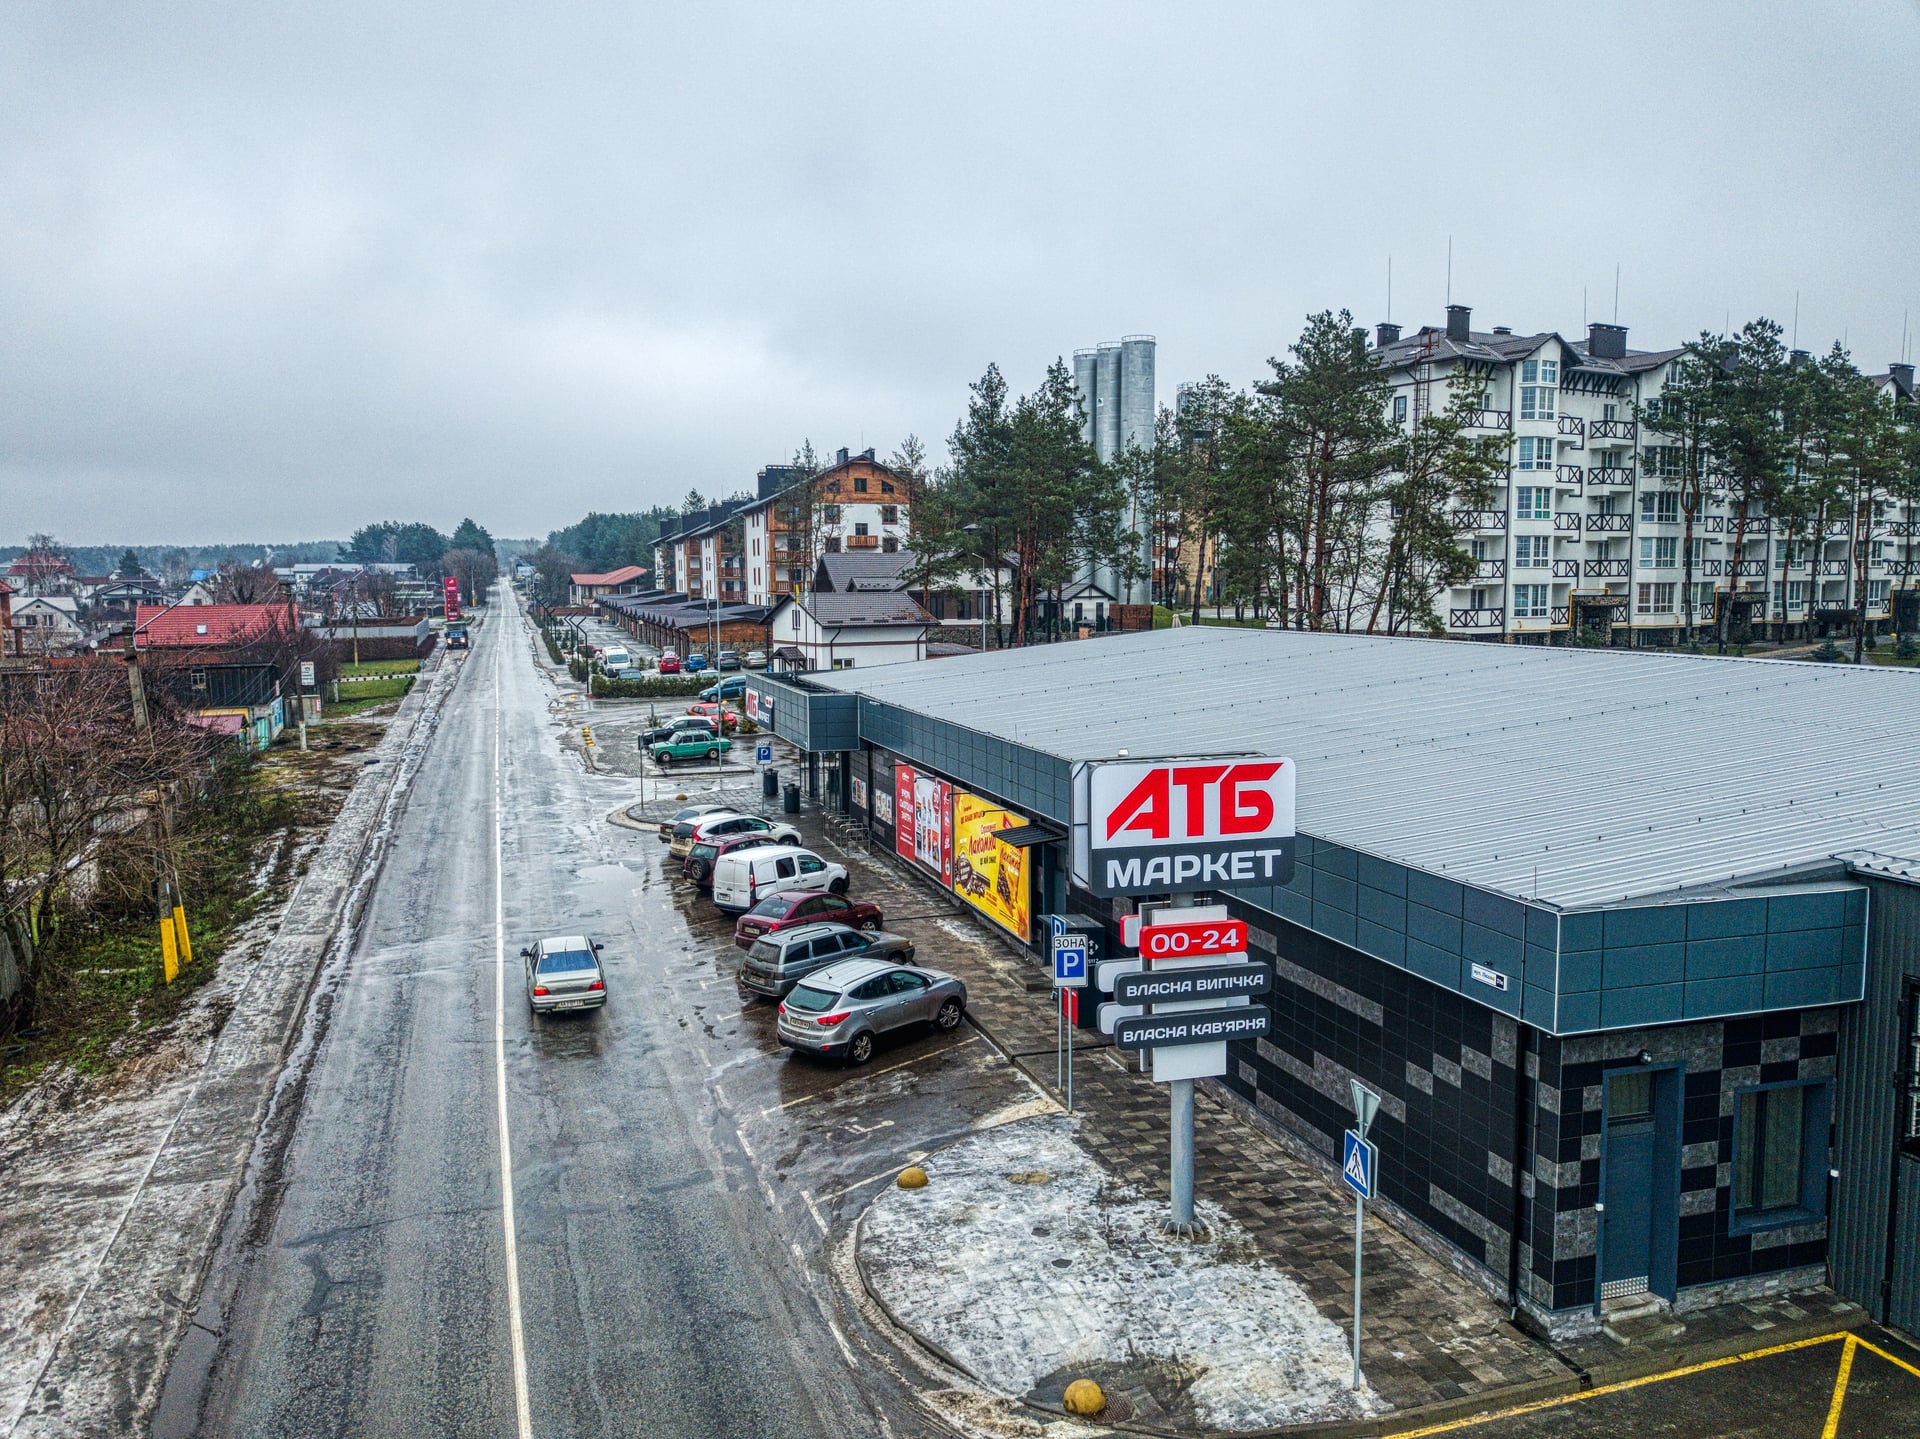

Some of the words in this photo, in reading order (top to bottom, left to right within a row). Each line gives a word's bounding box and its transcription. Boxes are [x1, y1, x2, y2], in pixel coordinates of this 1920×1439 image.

[761, 749, 769, 759] P
[1106, 762, 1284, 842] АТБ
[1106, 849, 1282, 889] МАРКЕТ
[1055, 938, 1086, 949] ЗОНА
[1150, 929, 1240, 953] 00-24
[1063, 952, 1079, 976] P
[1126, 980, 1192, 997] ВЛАСНА
[1196, 974, 1265, 990] ВИПІЧКА
[1123, 1025, 1188, 1043] ВЛАСНА
